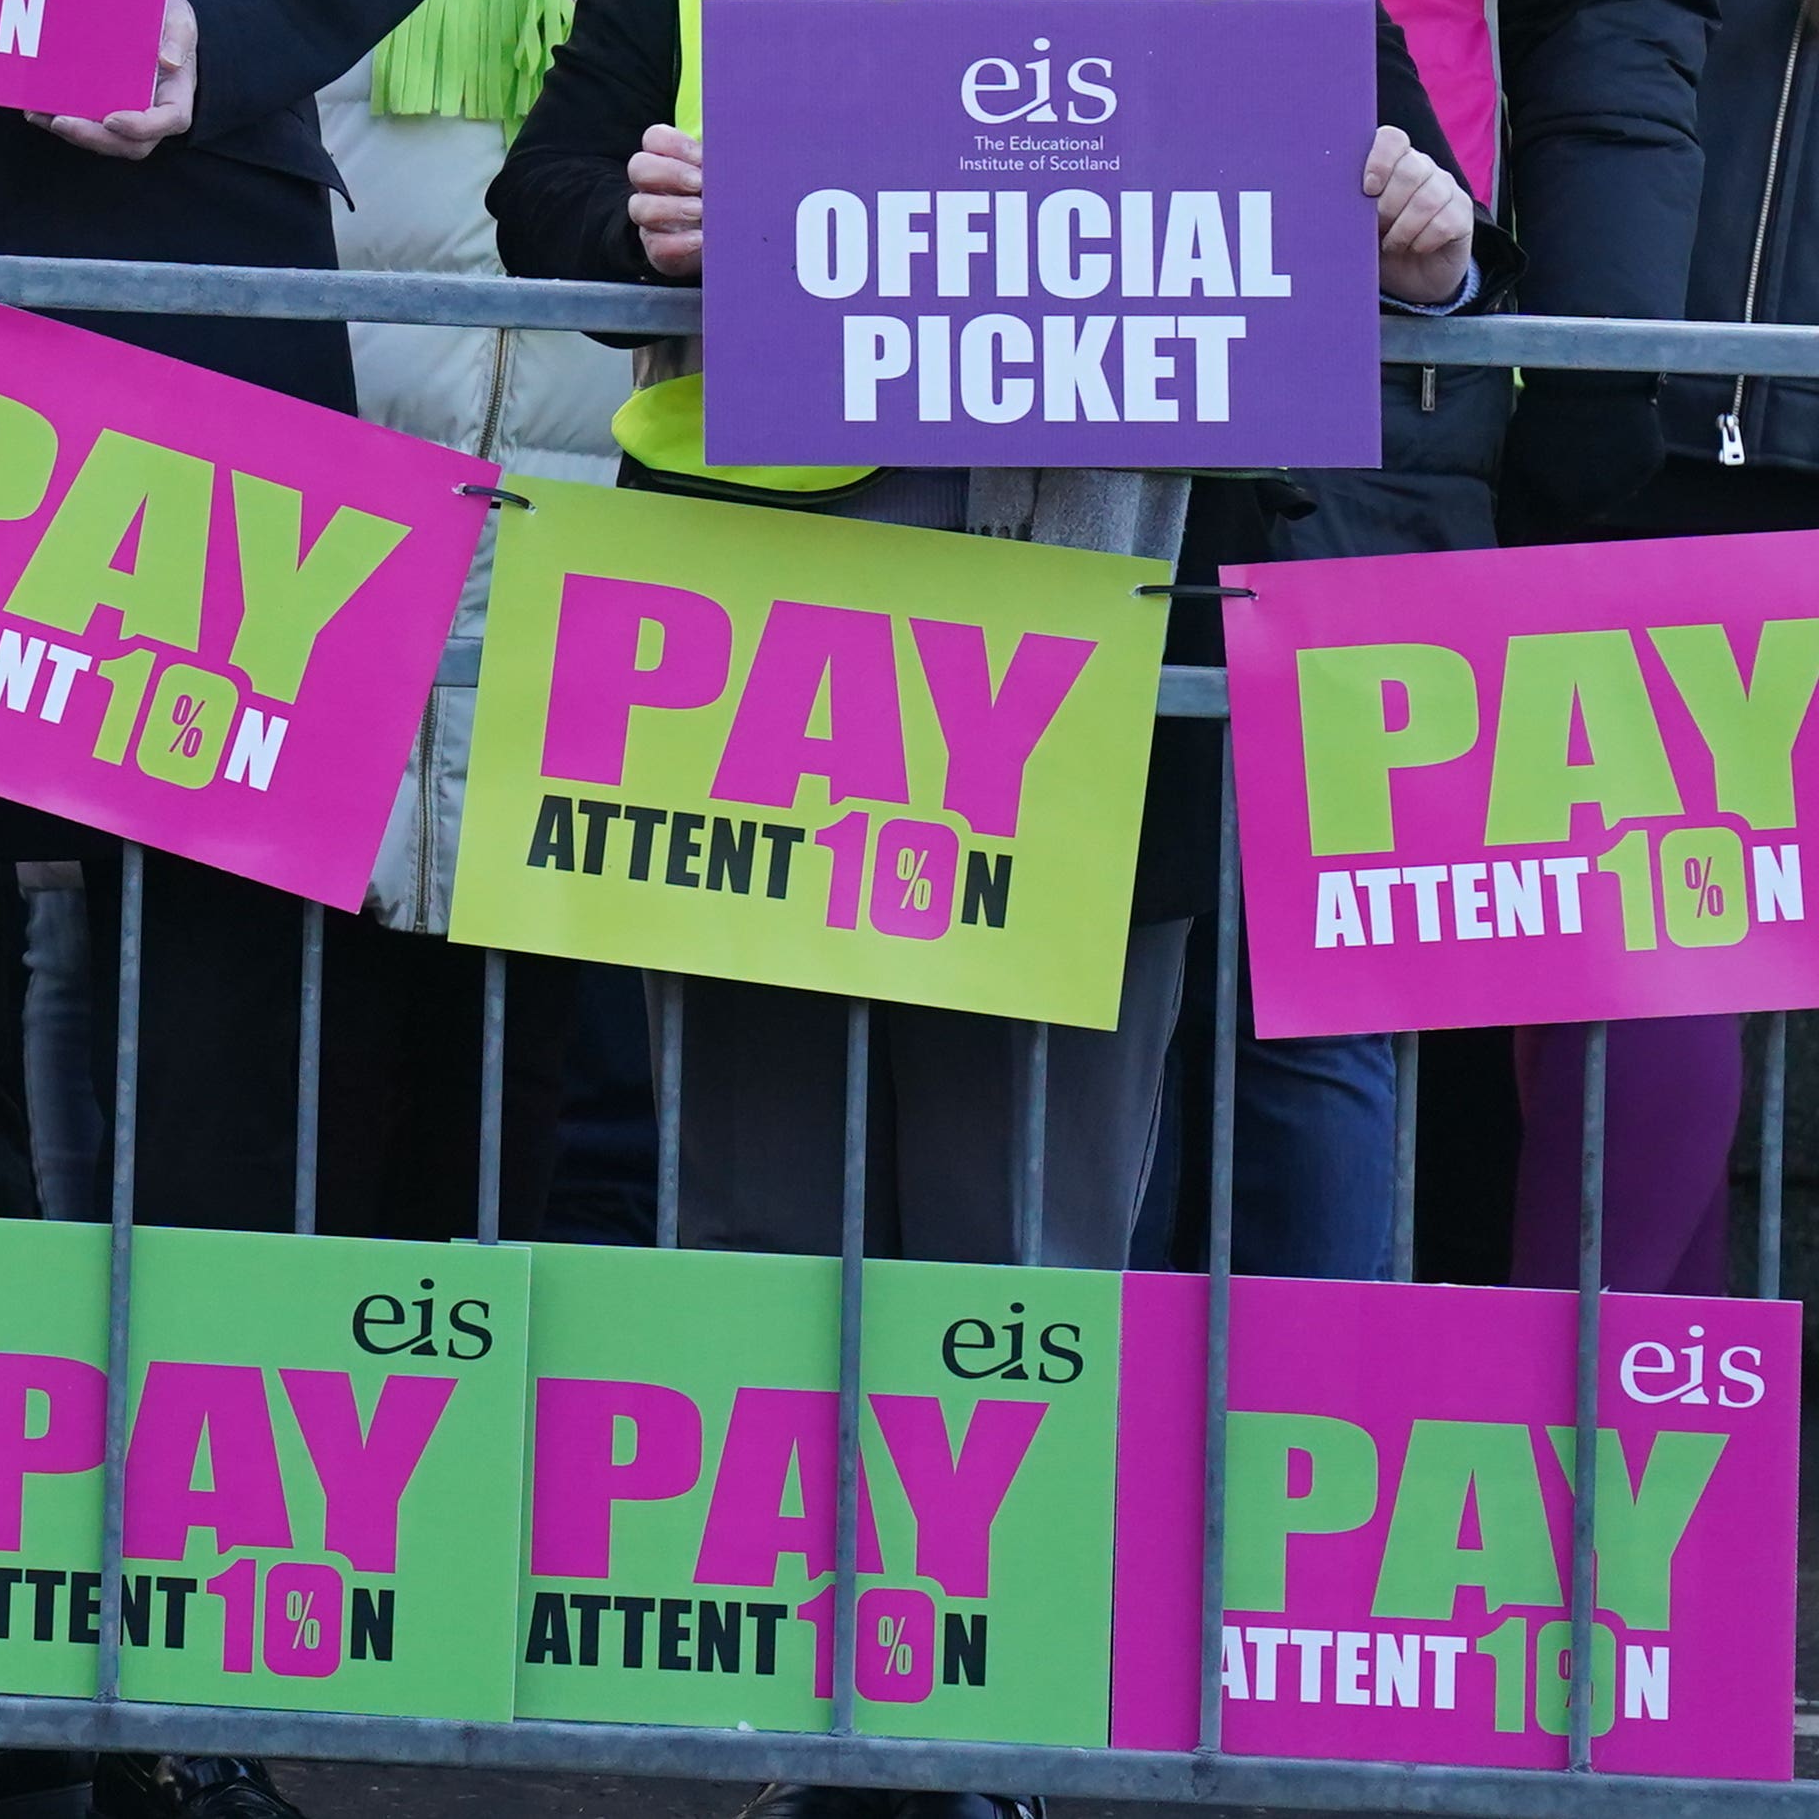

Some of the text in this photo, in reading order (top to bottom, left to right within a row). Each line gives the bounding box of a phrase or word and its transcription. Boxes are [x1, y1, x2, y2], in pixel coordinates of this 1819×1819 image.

[960, 37, 1119, 125] eis
[959, 154, 1121, 172] Institute of Scotland
[973, 135, 1105, 152] The Educational
[794, 188, 1292, 299] OFFICIAL
[842, 313, 1247, 425] PICKET
[539, 571, 1100, 839] PAY
[1295, 617, 1819, 857] PAY
[351, 1277, 494, 1361] eis
[941, 1301, 1085, 1384] eis
[1619, 1324, 1766, 1409] eis
[529, 1376, 1051, 1600] PAY
[1221, 1409, 1731, 1632] PAY
